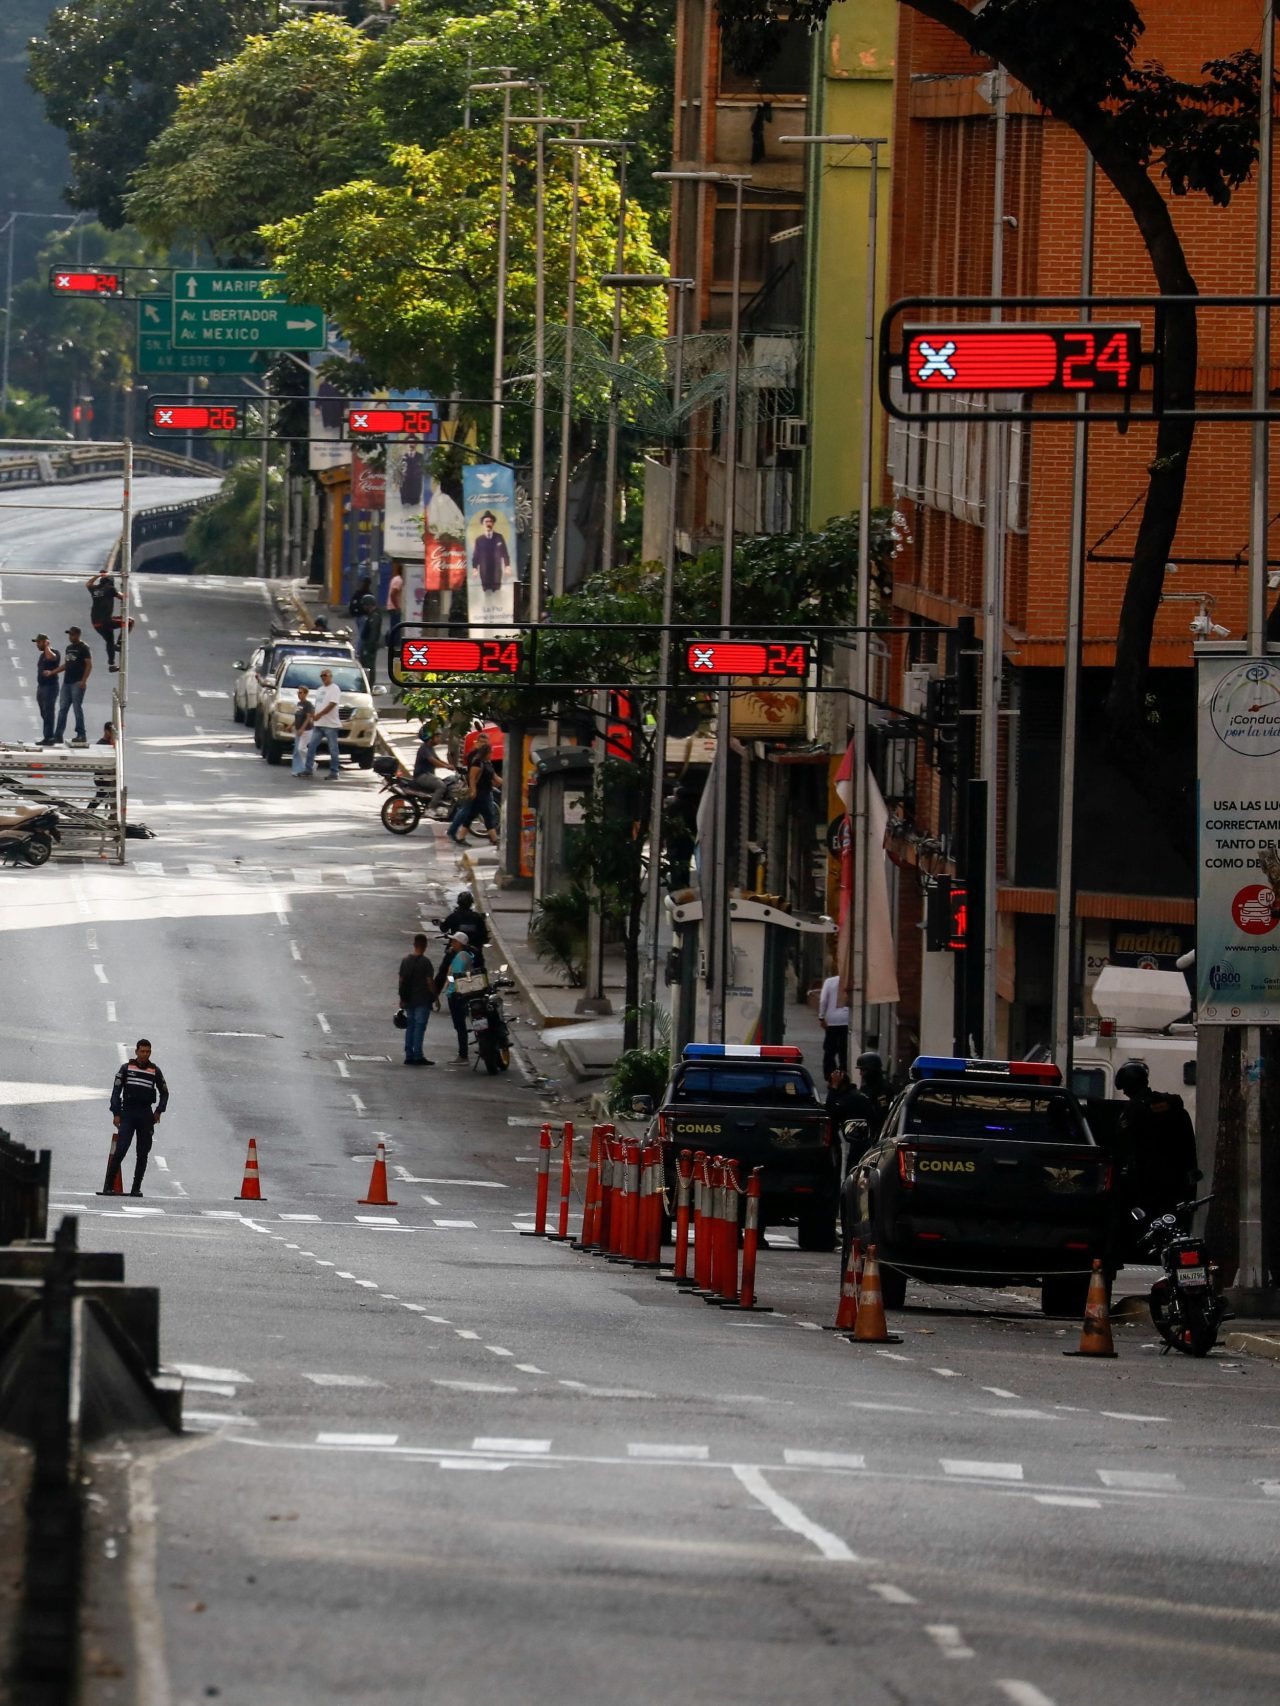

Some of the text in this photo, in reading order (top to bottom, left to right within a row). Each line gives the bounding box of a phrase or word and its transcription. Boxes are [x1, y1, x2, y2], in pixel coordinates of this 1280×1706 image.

[96, 274, 117, 292] 24
[212, 280, 264, 292] MARIP
[202, 309, 278, 321] LIBERTADOR
[203, 328, 260, 340] MEXICO
[181, 356, 211, 367] ESTE
[1062, 332, 1131, 388] 24
[210, 408, 236, 430] 26
[404, 411, 431, 433] 26
[482, 642, 519, 672] 24
[768, 645, 805, 675] 24
[1224, 728, 1245, 740] por
[1247, 725, 1259, 737] la
[1213, 801, 1237, 811] USA
[1240, 801, 1261, 811] LAS
[1216, 839, 1255, 849] TANTO
[1205, 858, 1243, 868] COMO
[1214, 973, 1240, 983] 0800
[676, 1124, 722, 1133] CONAS
[920, 1160, 976, 1172] CONAS
